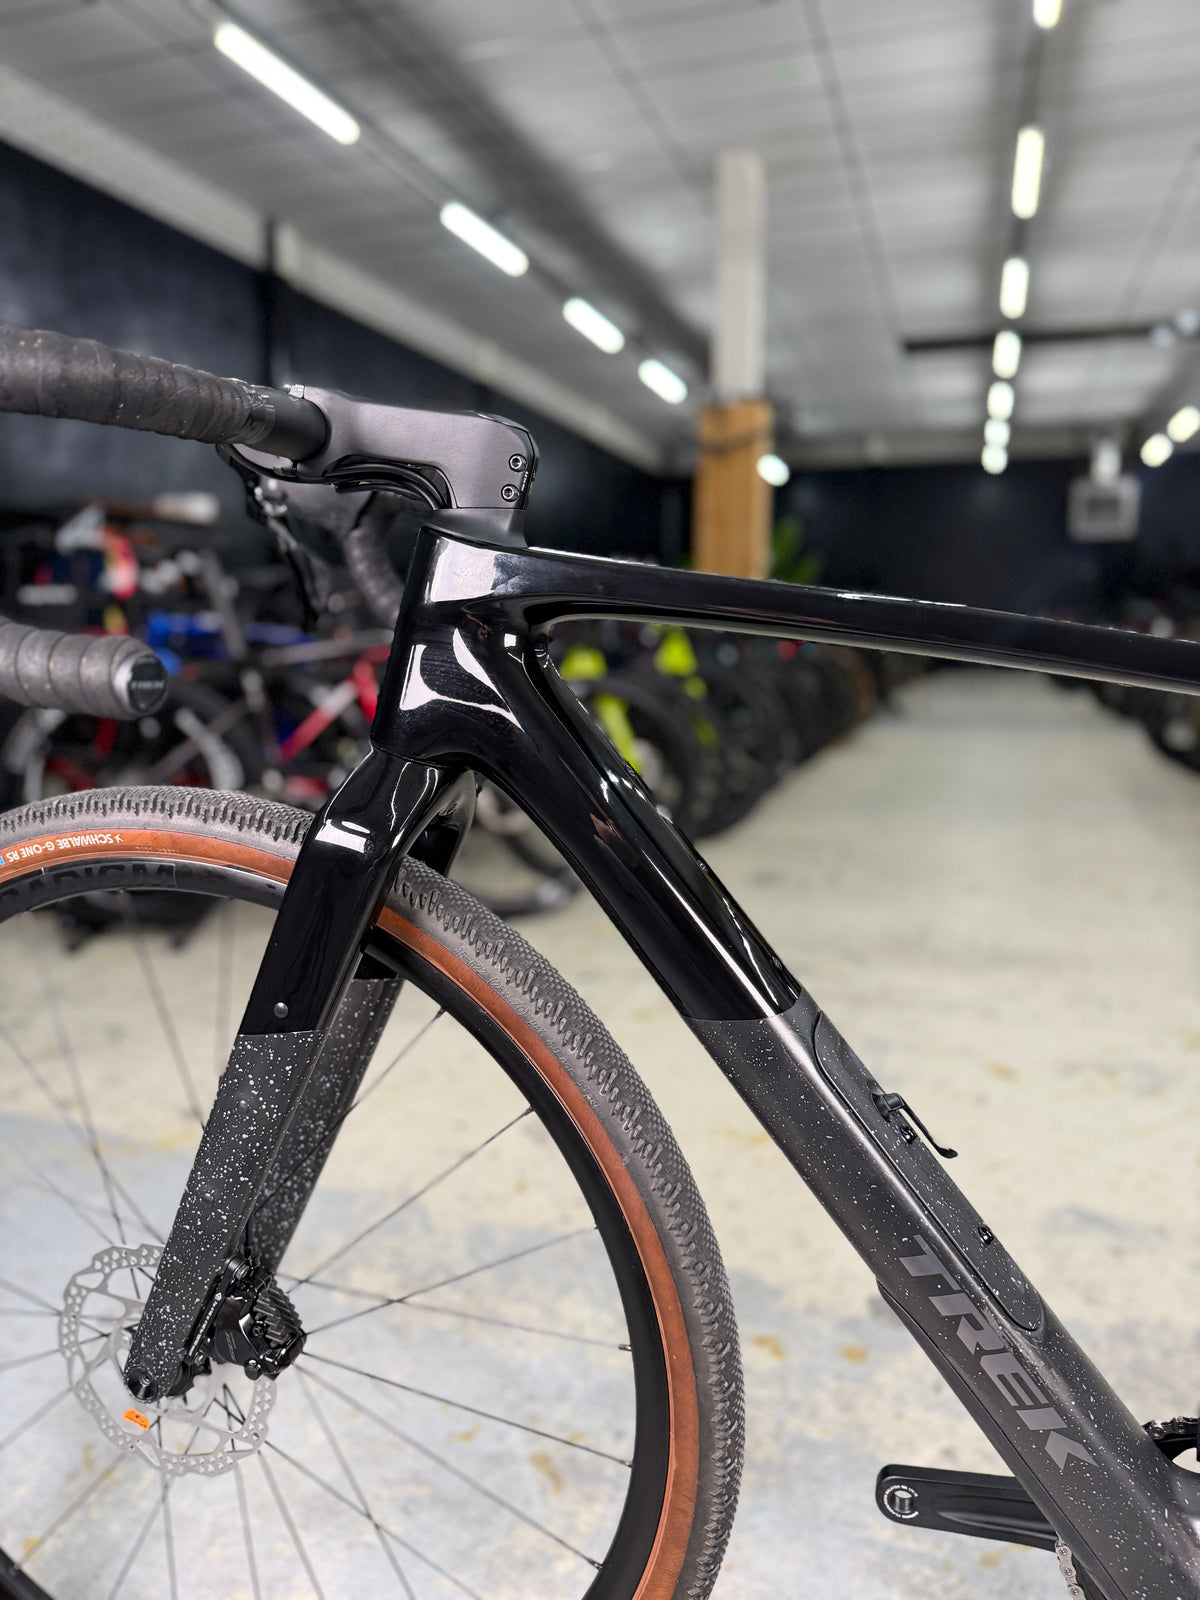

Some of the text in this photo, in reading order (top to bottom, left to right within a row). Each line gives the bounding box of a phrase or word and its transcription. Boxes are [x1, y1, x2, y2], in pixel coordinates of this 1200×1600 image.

[20, 841, 55, 858] G-ONE
[56, 834, 114, 849] SCHWALBE
[6, 851, 20, 862] RS
[899, 1234, 1100, 1472] TREK
